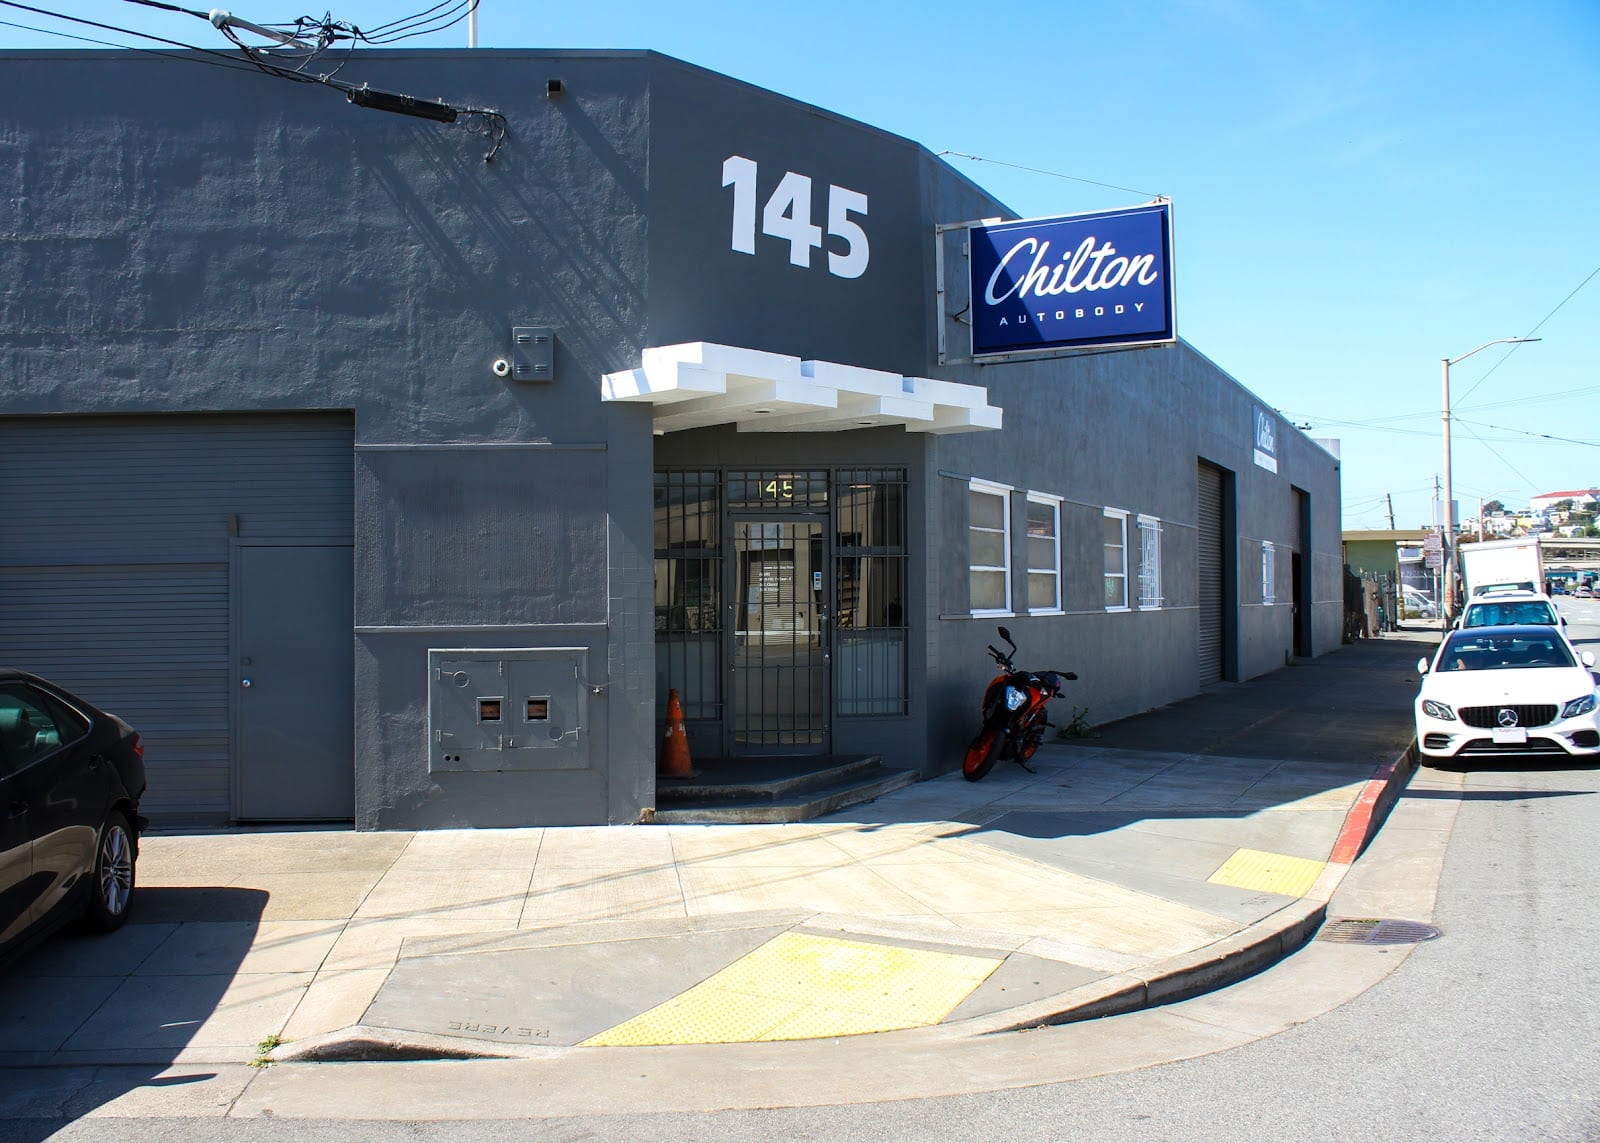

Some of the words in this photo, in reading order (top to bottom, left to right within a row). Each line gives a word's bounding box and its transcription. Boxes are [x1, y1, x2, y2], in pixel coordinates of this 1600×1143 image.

[722, 155, 869, 279] 145
[985, 236, 1158, 306] Chilton
[1000, 302, 1144, 326] AUTOBODY
[758, 480, 793, 498] 145
[448, 1022, 550, 1039] REVERE
